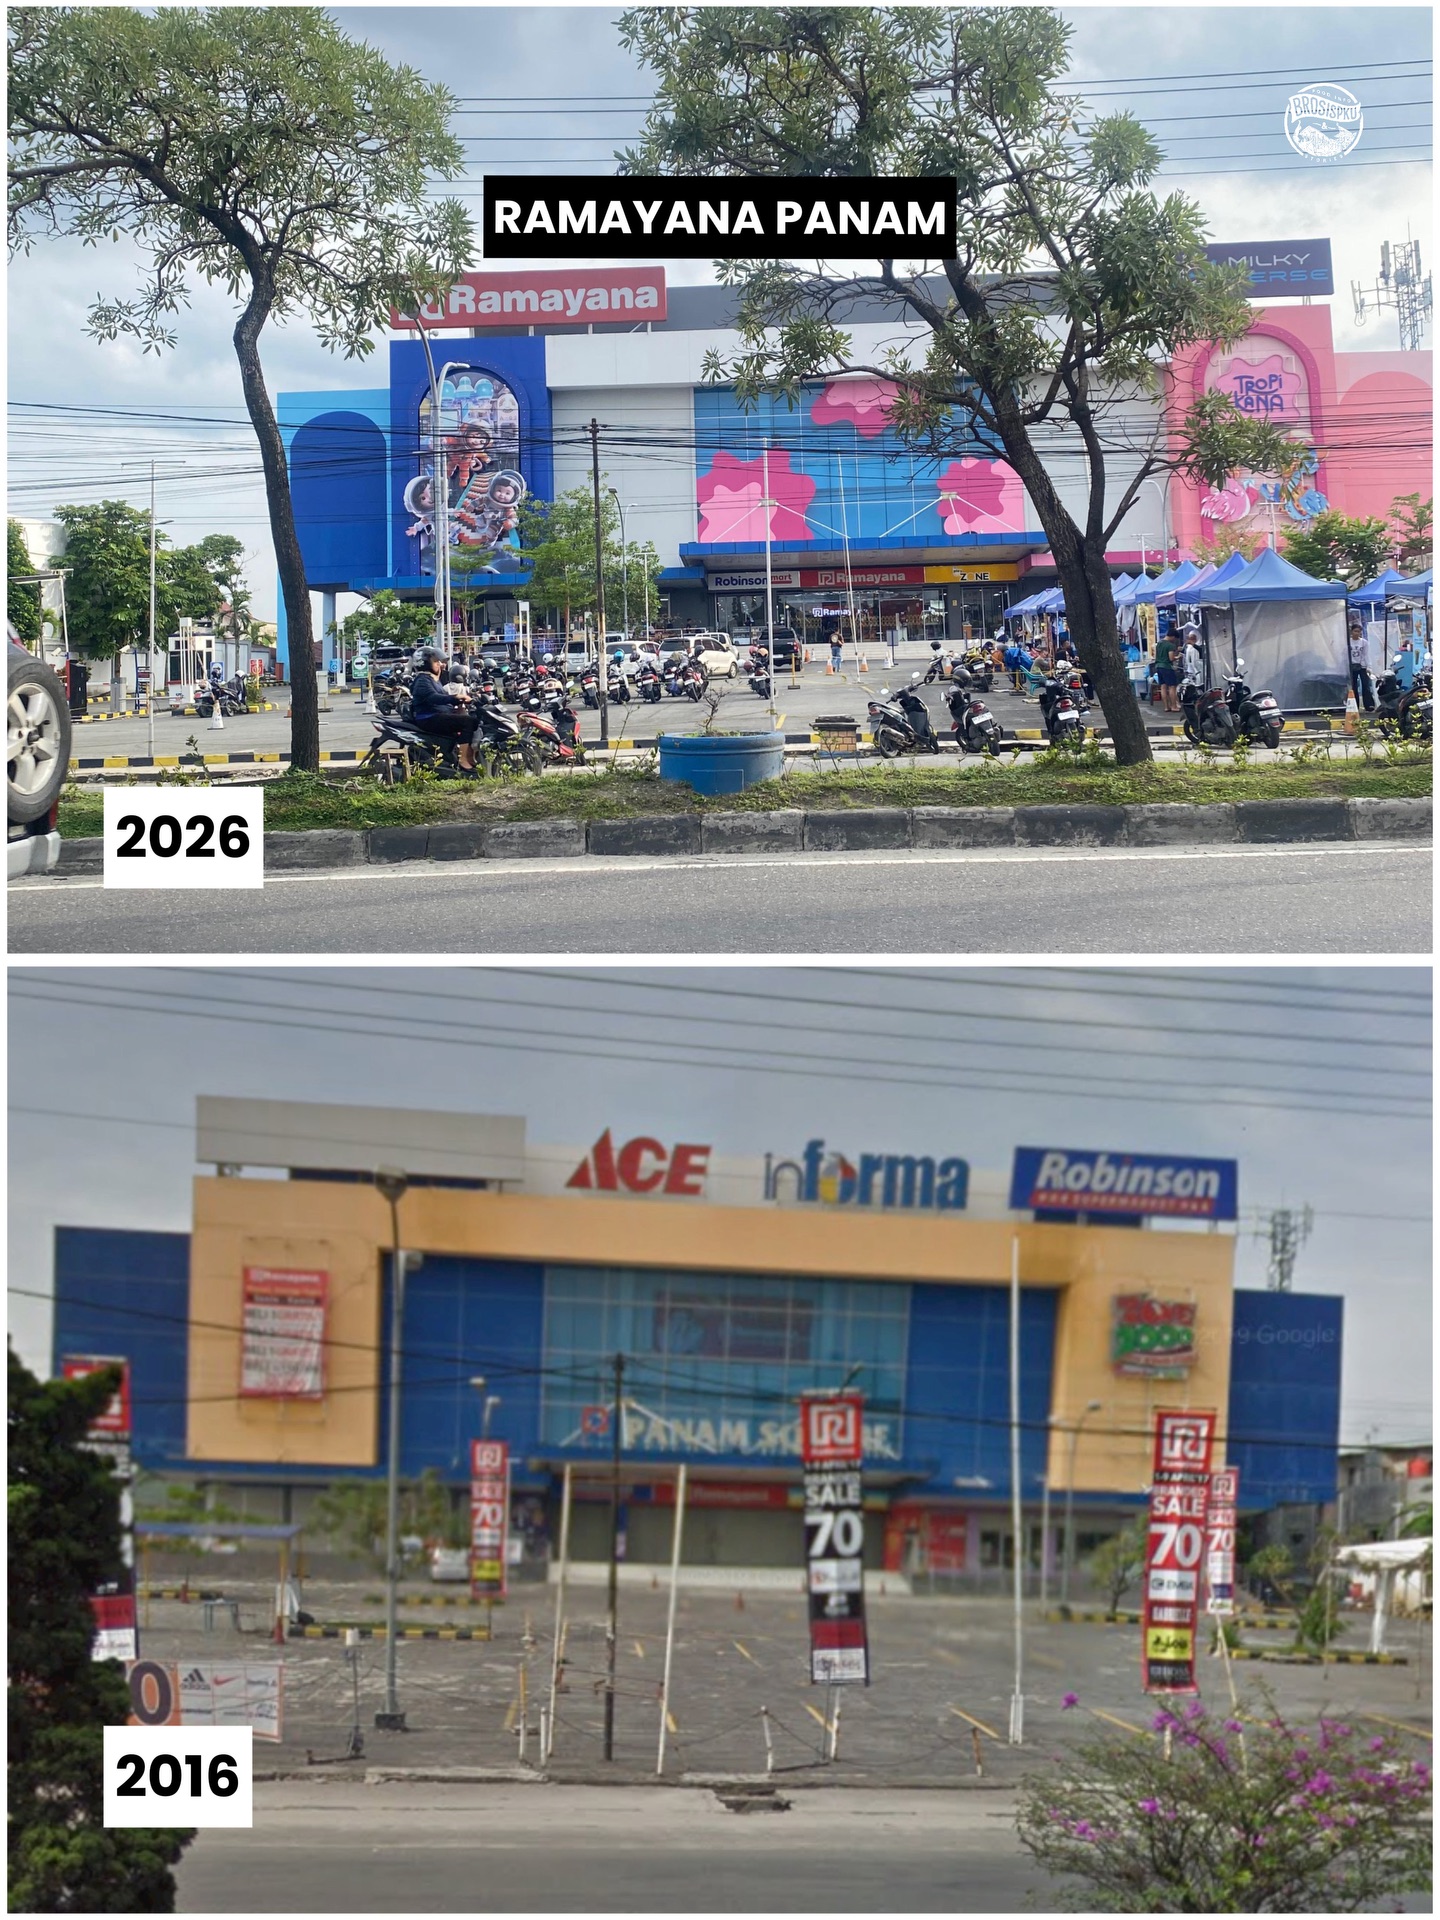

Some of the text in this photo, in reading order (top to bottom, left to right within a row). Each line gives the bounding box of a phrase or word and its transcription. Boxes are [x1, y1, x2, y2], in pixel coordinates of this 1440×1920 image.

[1228, 253, 1310, 267] MILKY
[1238, 268, 1329, 283] ERSE
[450, 285, 659, 316] Ramayana
[1234, 390, 1284, 413] KANA
[960, 571, 990, 582] ZONE
[564, 1127, 712, 1195] ACE
[764, 1140, 971, 1210] informa
[1036, 1152, 1221, 1199] Robinson
[628, 1418, 747, 1451] PANAM
[806, 1484, 861, 1506] SALE
[1153, 1497, 1205, 1517] SALE
[471, 1501, 503, 1527] 70
[804, 1509, 864, 1558] 70
[1149, 1523, 1202, 1568] 70
[1206, 1528, 1236, 1552] 70
